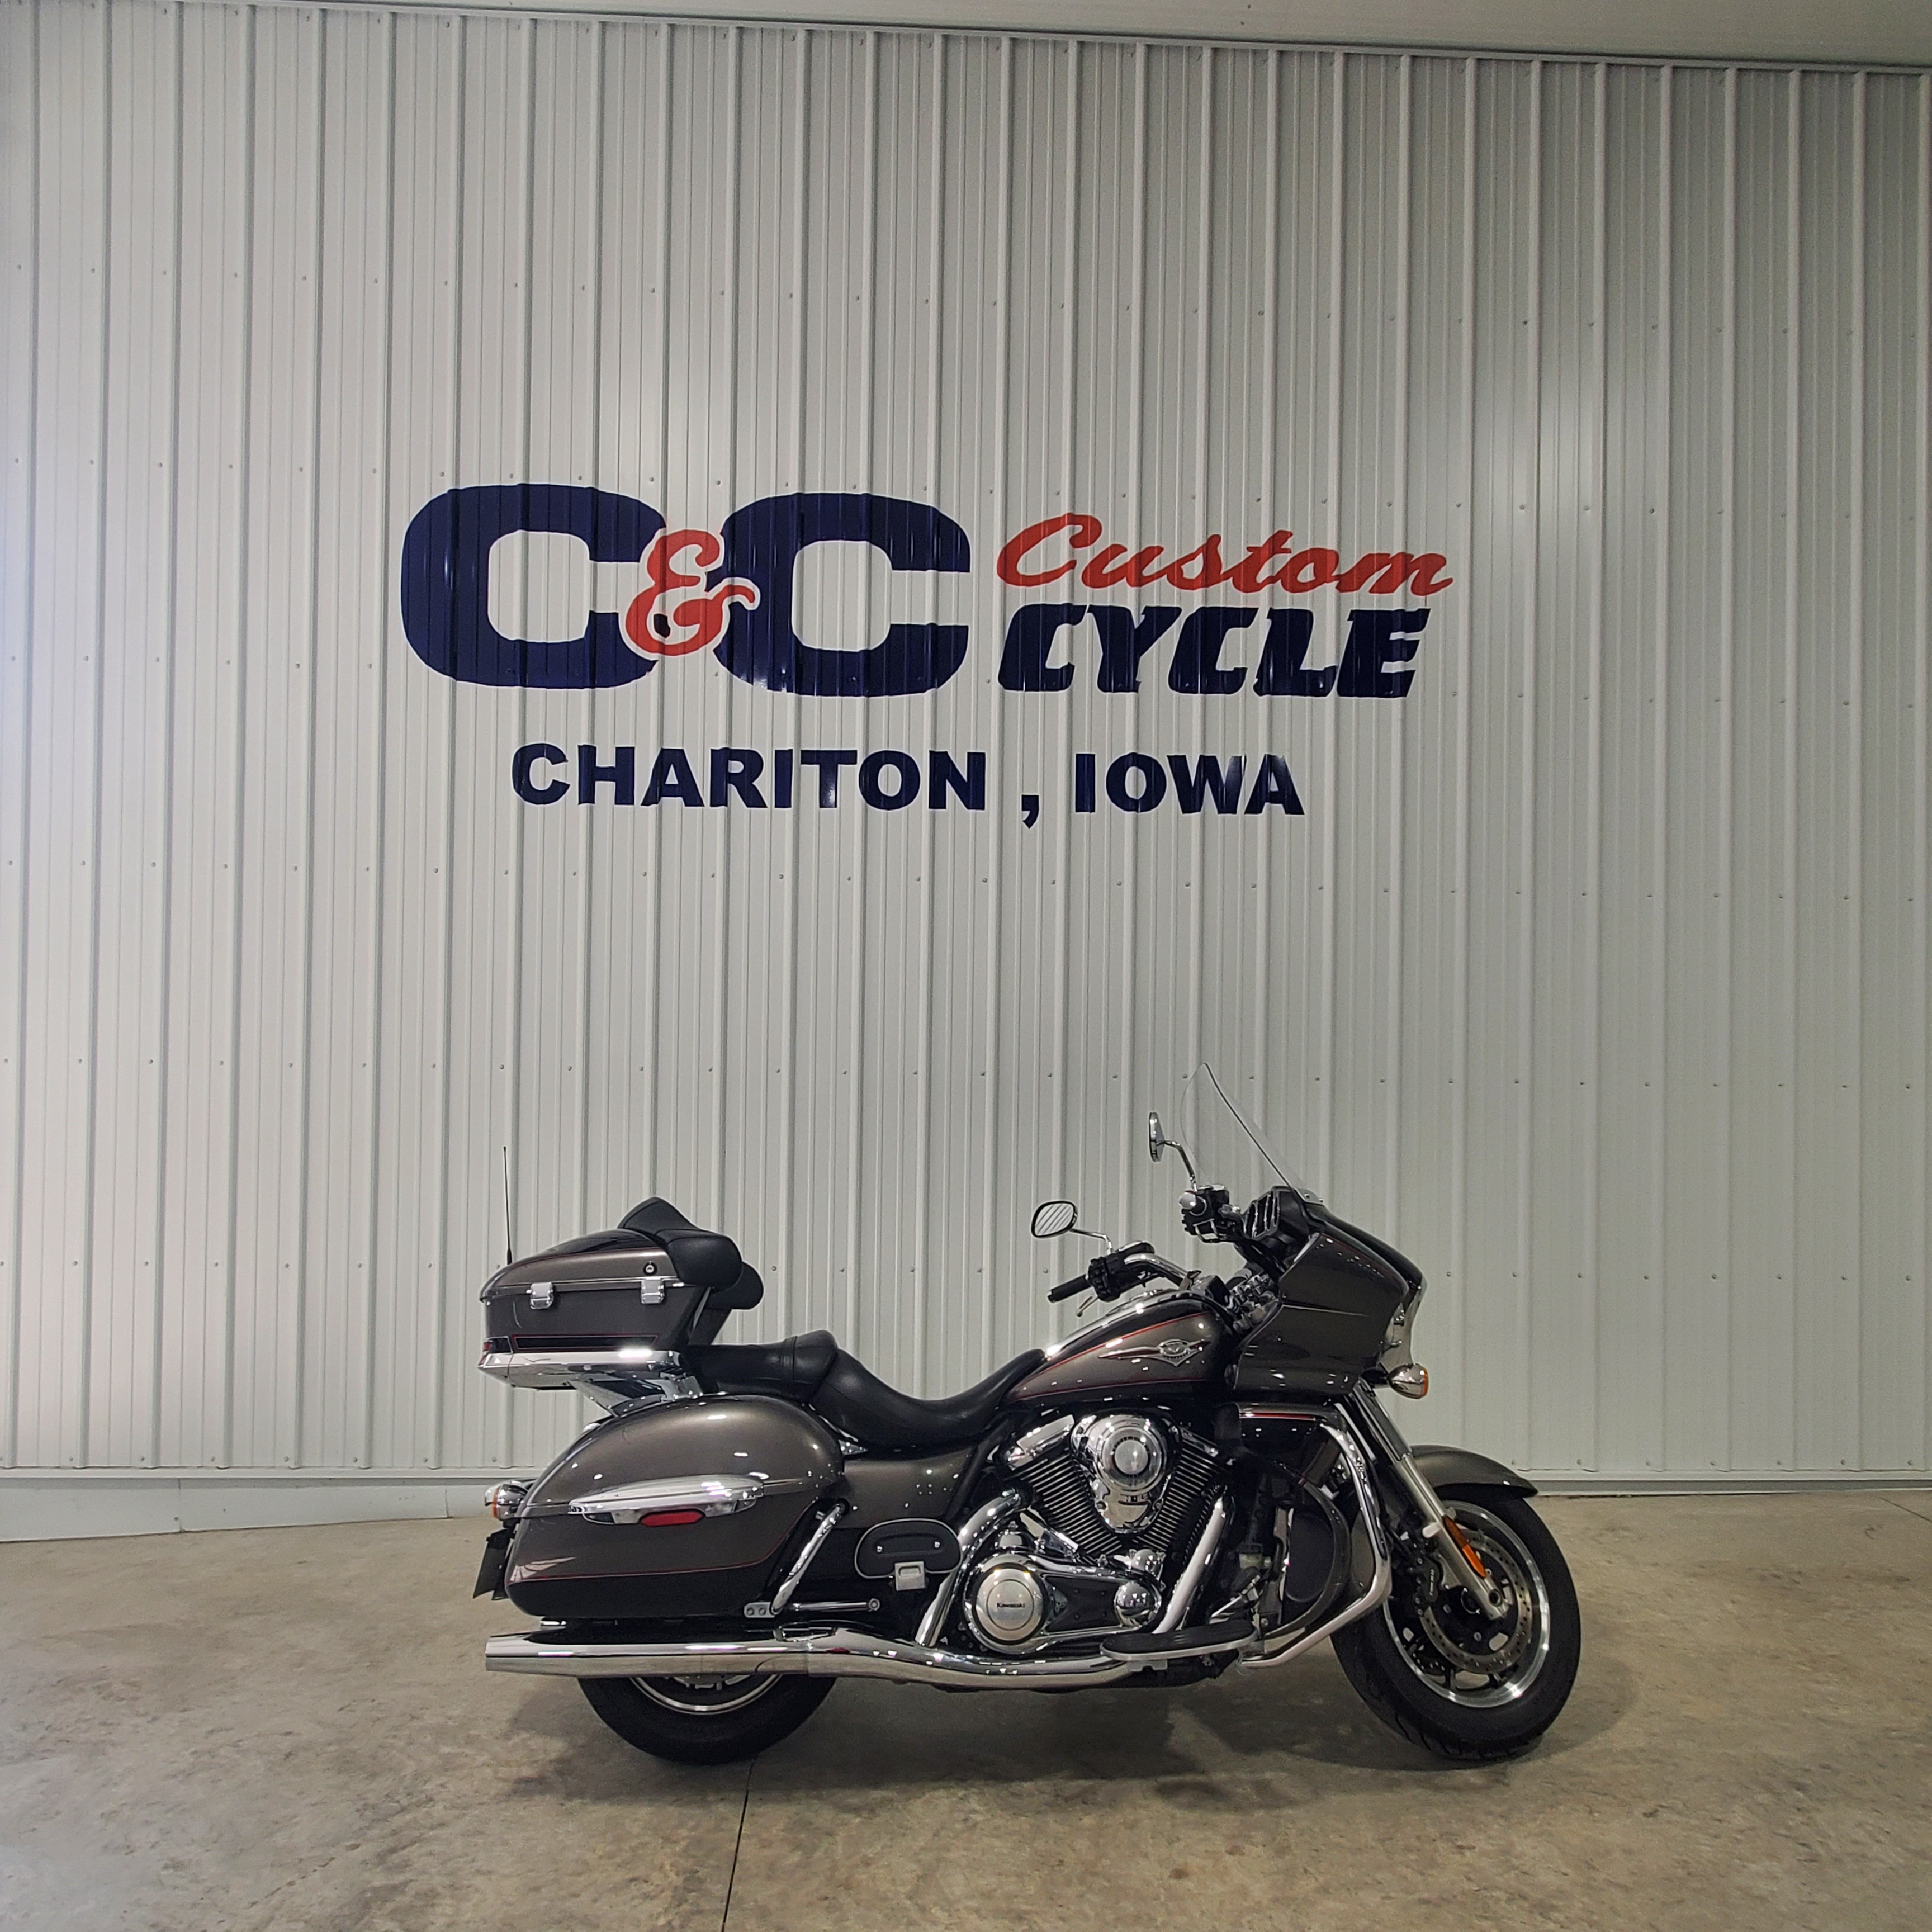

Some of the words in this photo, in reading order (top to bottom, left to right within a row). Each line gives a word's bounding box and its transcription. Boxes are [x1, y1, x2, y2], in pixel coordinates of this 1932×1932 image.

[401, 483, 971, 698] C&C
[997, 513, 1453, 598] Custom
[998, 602, 1431, 698] CYCLE
[513, 743, 986, 812] CHARITON
[1076, 752, 1305, 815] IOWA
